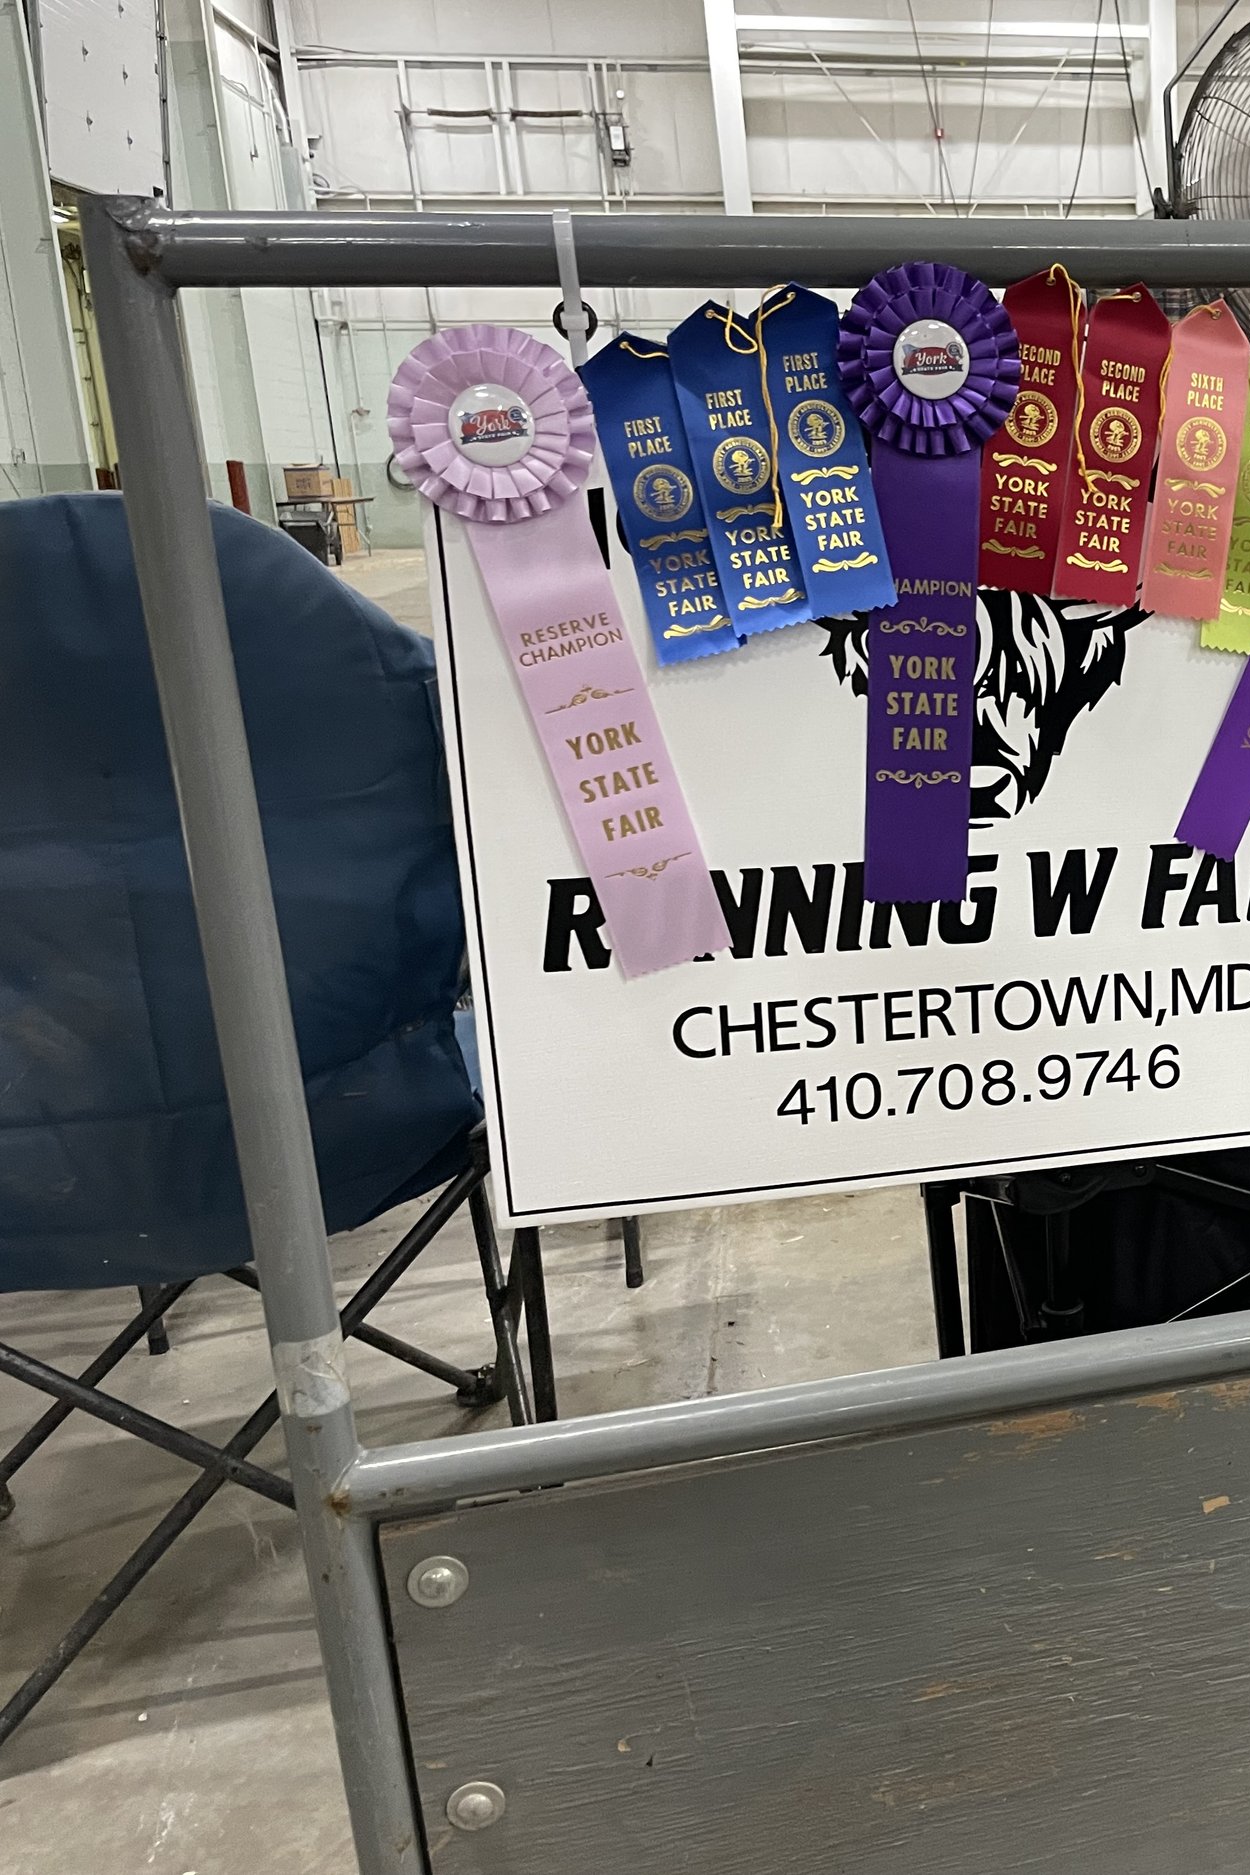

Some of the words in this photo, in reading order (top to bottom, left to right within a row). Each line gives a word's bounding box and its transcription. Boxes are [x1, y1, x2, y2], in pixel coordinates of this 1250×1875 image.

[783, 352, 818, 372] FIRST
[915, 352, 948, 367] York
[785, 372, 828, 393] PLACE
[1100, 359, 1146, 384] SECOND
[1191, 372, 1224, 392] SIXTH
[705, 389, 743, 410] FIRST
[1101, 381, 1141, 403] PLACE
[1187, 390, 1224, 411] PLACE
[470, 414, 512, 436] York
[624, 416, 662, 438] FIRST
[708, 409, 753, 431] PLACE
[628, 436, 673, 459] PLACE
[800, 485, 860, 508] YORK
[995, 473, 1050, 497] YORK
[990, 495, 1048, 519] STATE
[1080, 488, 1133, 512] YORK
[1167, 498, 1219, 520] YORK
[805, 508, 866, 531] STATE
[994, 517, 1037, 539] FAIR
[1075, 510, 1131, 534] STATE
[1161, 519, 1217, 541] STATE
[725, 526, 785, 546] YORK
[817, 530, 864, 551] FAIR
[1079, 531, 1120, 553] FAIR
[649, 549, 711, 574] YORK
[730, 545, 791, 569] STATE
[1167, 540, 1208, 561] FAIR
[656, 571, 718, 597] STATE
[742, 567, 791, 589] FAIR
[668, 595, 717, 617] FAIR
[521, 611, 610, 647] RESERVE
[519, 628, 623, 667] CHAMPION
[889, 655, 956, 681] YORK
[886, 692, 958, 716] STATE
[565, 721, 642, 760] YORK
[892, 727, 948, 751] FAIR
[579, 761, 659, 804] STATE
[601, 806, 664, 842] FAIR
[543, 854, 999, 973] RNNING
[1026, 847, 1118, 937] W
[776, 1044, 1182, 1126] 410.708.9746
